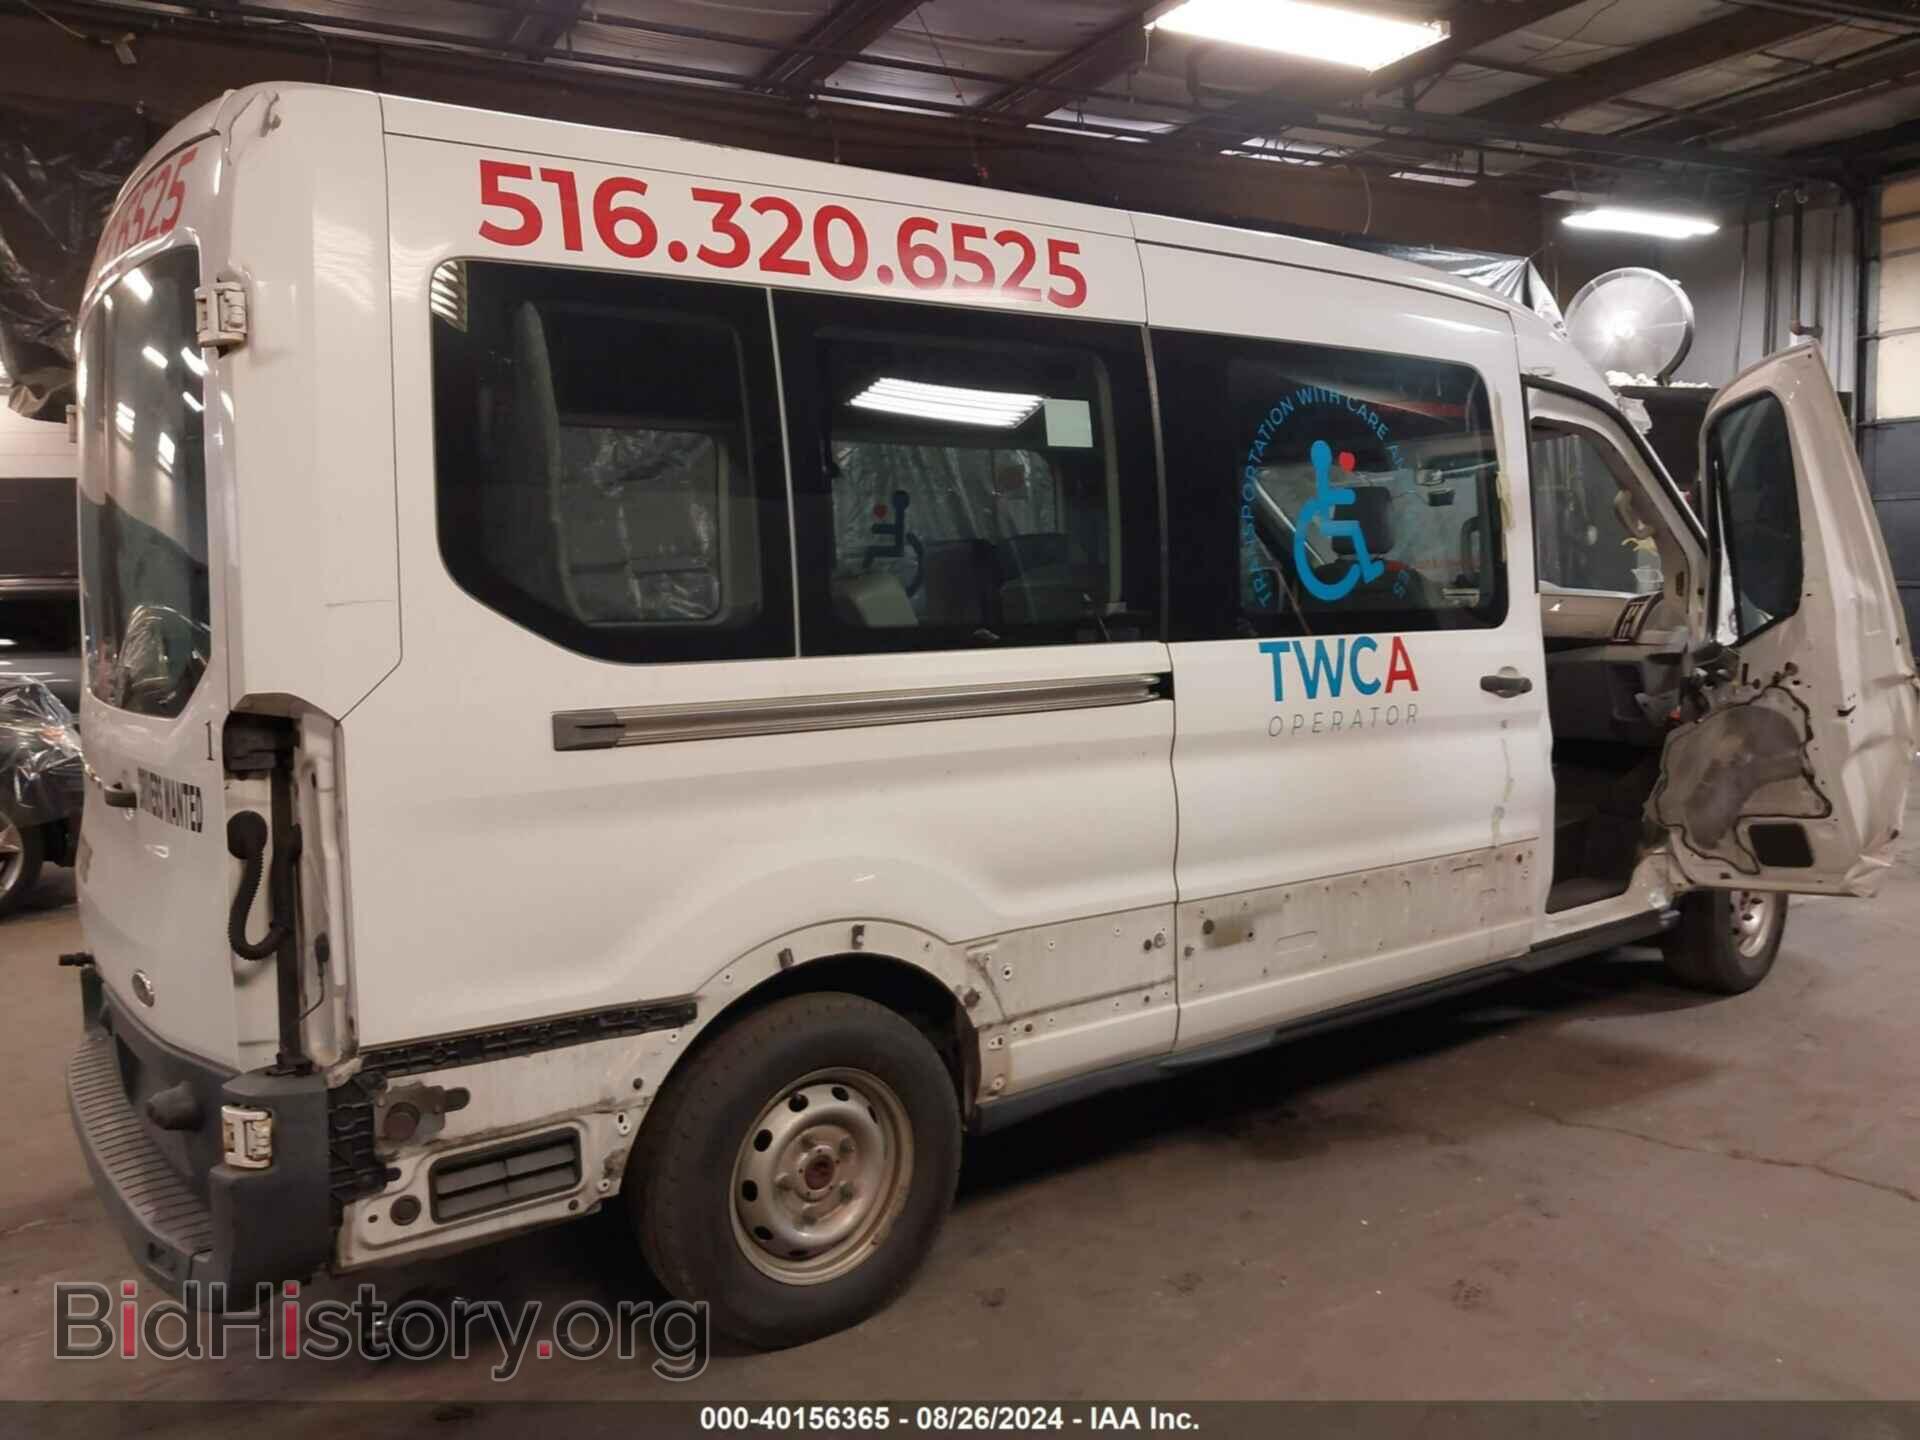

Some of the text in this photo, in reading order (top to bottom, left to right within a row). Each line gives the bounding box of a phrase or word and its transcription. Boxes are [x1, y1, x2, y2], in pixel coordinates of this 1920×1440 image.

[478, 159, 1088, 309] 516.320.6525
[1296, 386, 1341, 407] WITH
[1348, 397, 1390, 440] CARE
[1258, 635, 1419, 702] TWCA
[1268, 703, 1420, 737] OPERATOR
